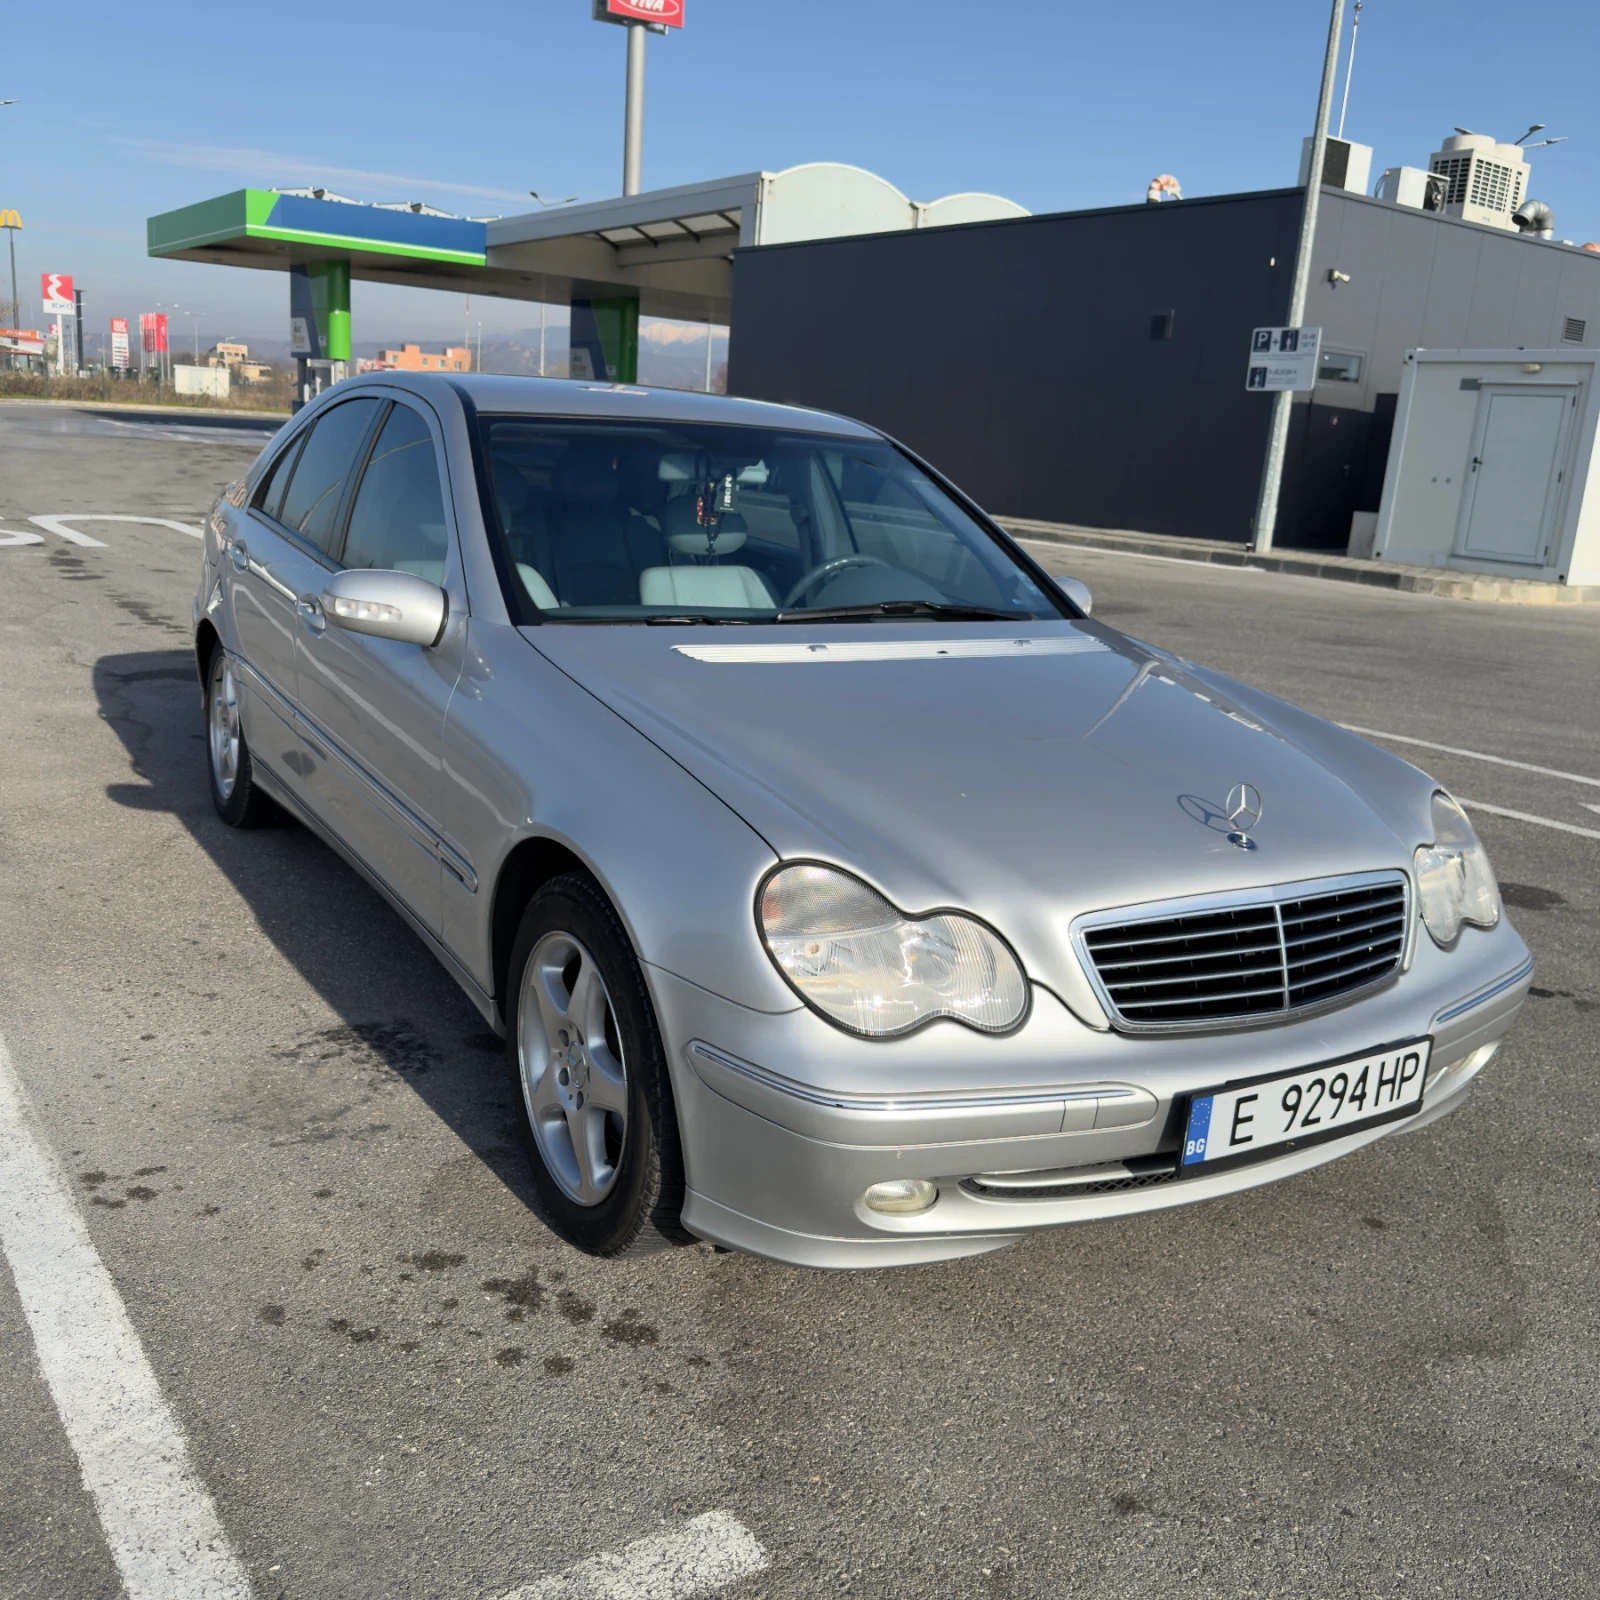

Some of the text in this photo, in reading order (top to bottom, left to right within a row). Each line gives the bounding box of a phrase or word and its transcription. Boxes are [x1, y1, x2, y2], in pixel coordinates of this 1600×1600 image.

[1229, 1051, 1420, 1147] E 9294 HP
[1185, 1138, 1206, 1156] BG
